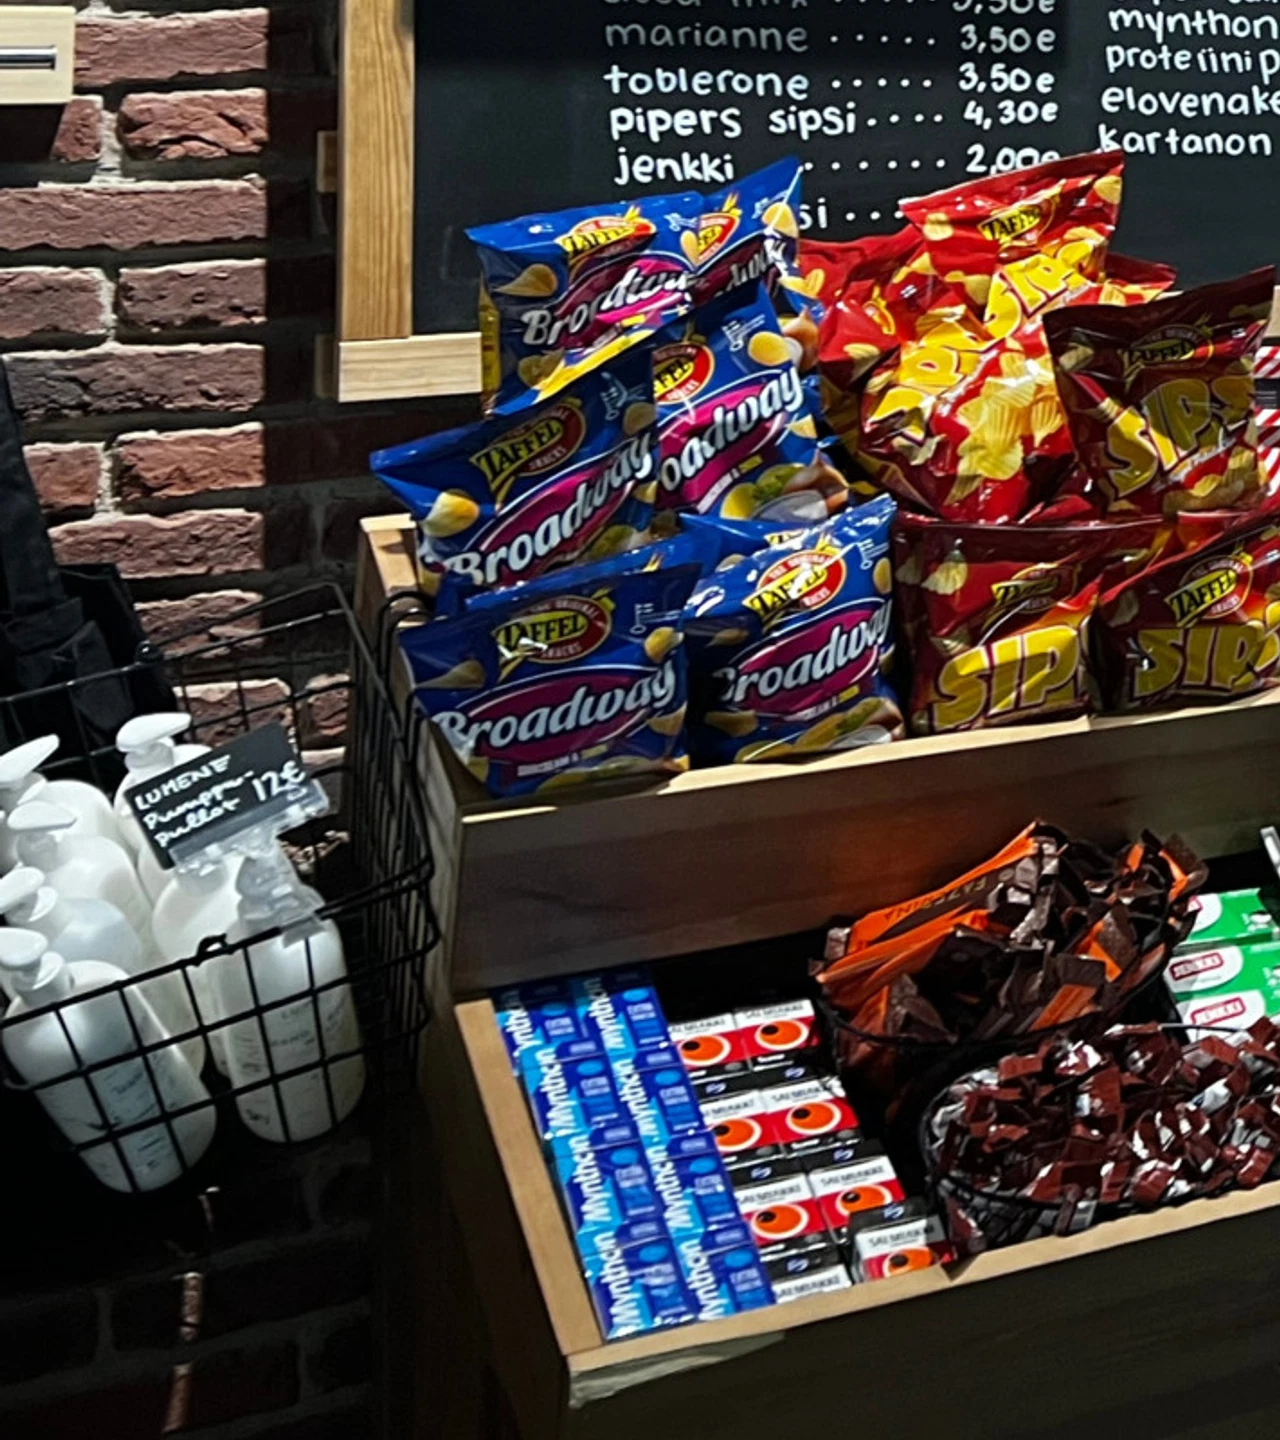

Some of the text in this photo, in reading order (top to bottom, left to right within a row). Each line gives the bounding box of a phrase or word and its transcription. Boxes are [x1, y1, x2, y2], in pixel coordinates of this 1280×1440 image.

[605, 22, 1056, 53] marianne 3,50e
[1108, 9, 1279, 44] mynthon
[603, 63, 1055, 100] toblerone 3,50e
[610, 101, 1059, 142] pipers sipsi 4,30e
[1098, 123, 1272, 157] kartanon
[614, 147, 734, 185] jenkki
[658, 365, 804, 492] oadway
[477, 418, 563, 482] TAFFEL
[1168, 568, 1237, 619] TAFFEL
[932, 623, 1078, 732] SIP
[432, 659, 677, 751] Broadway
